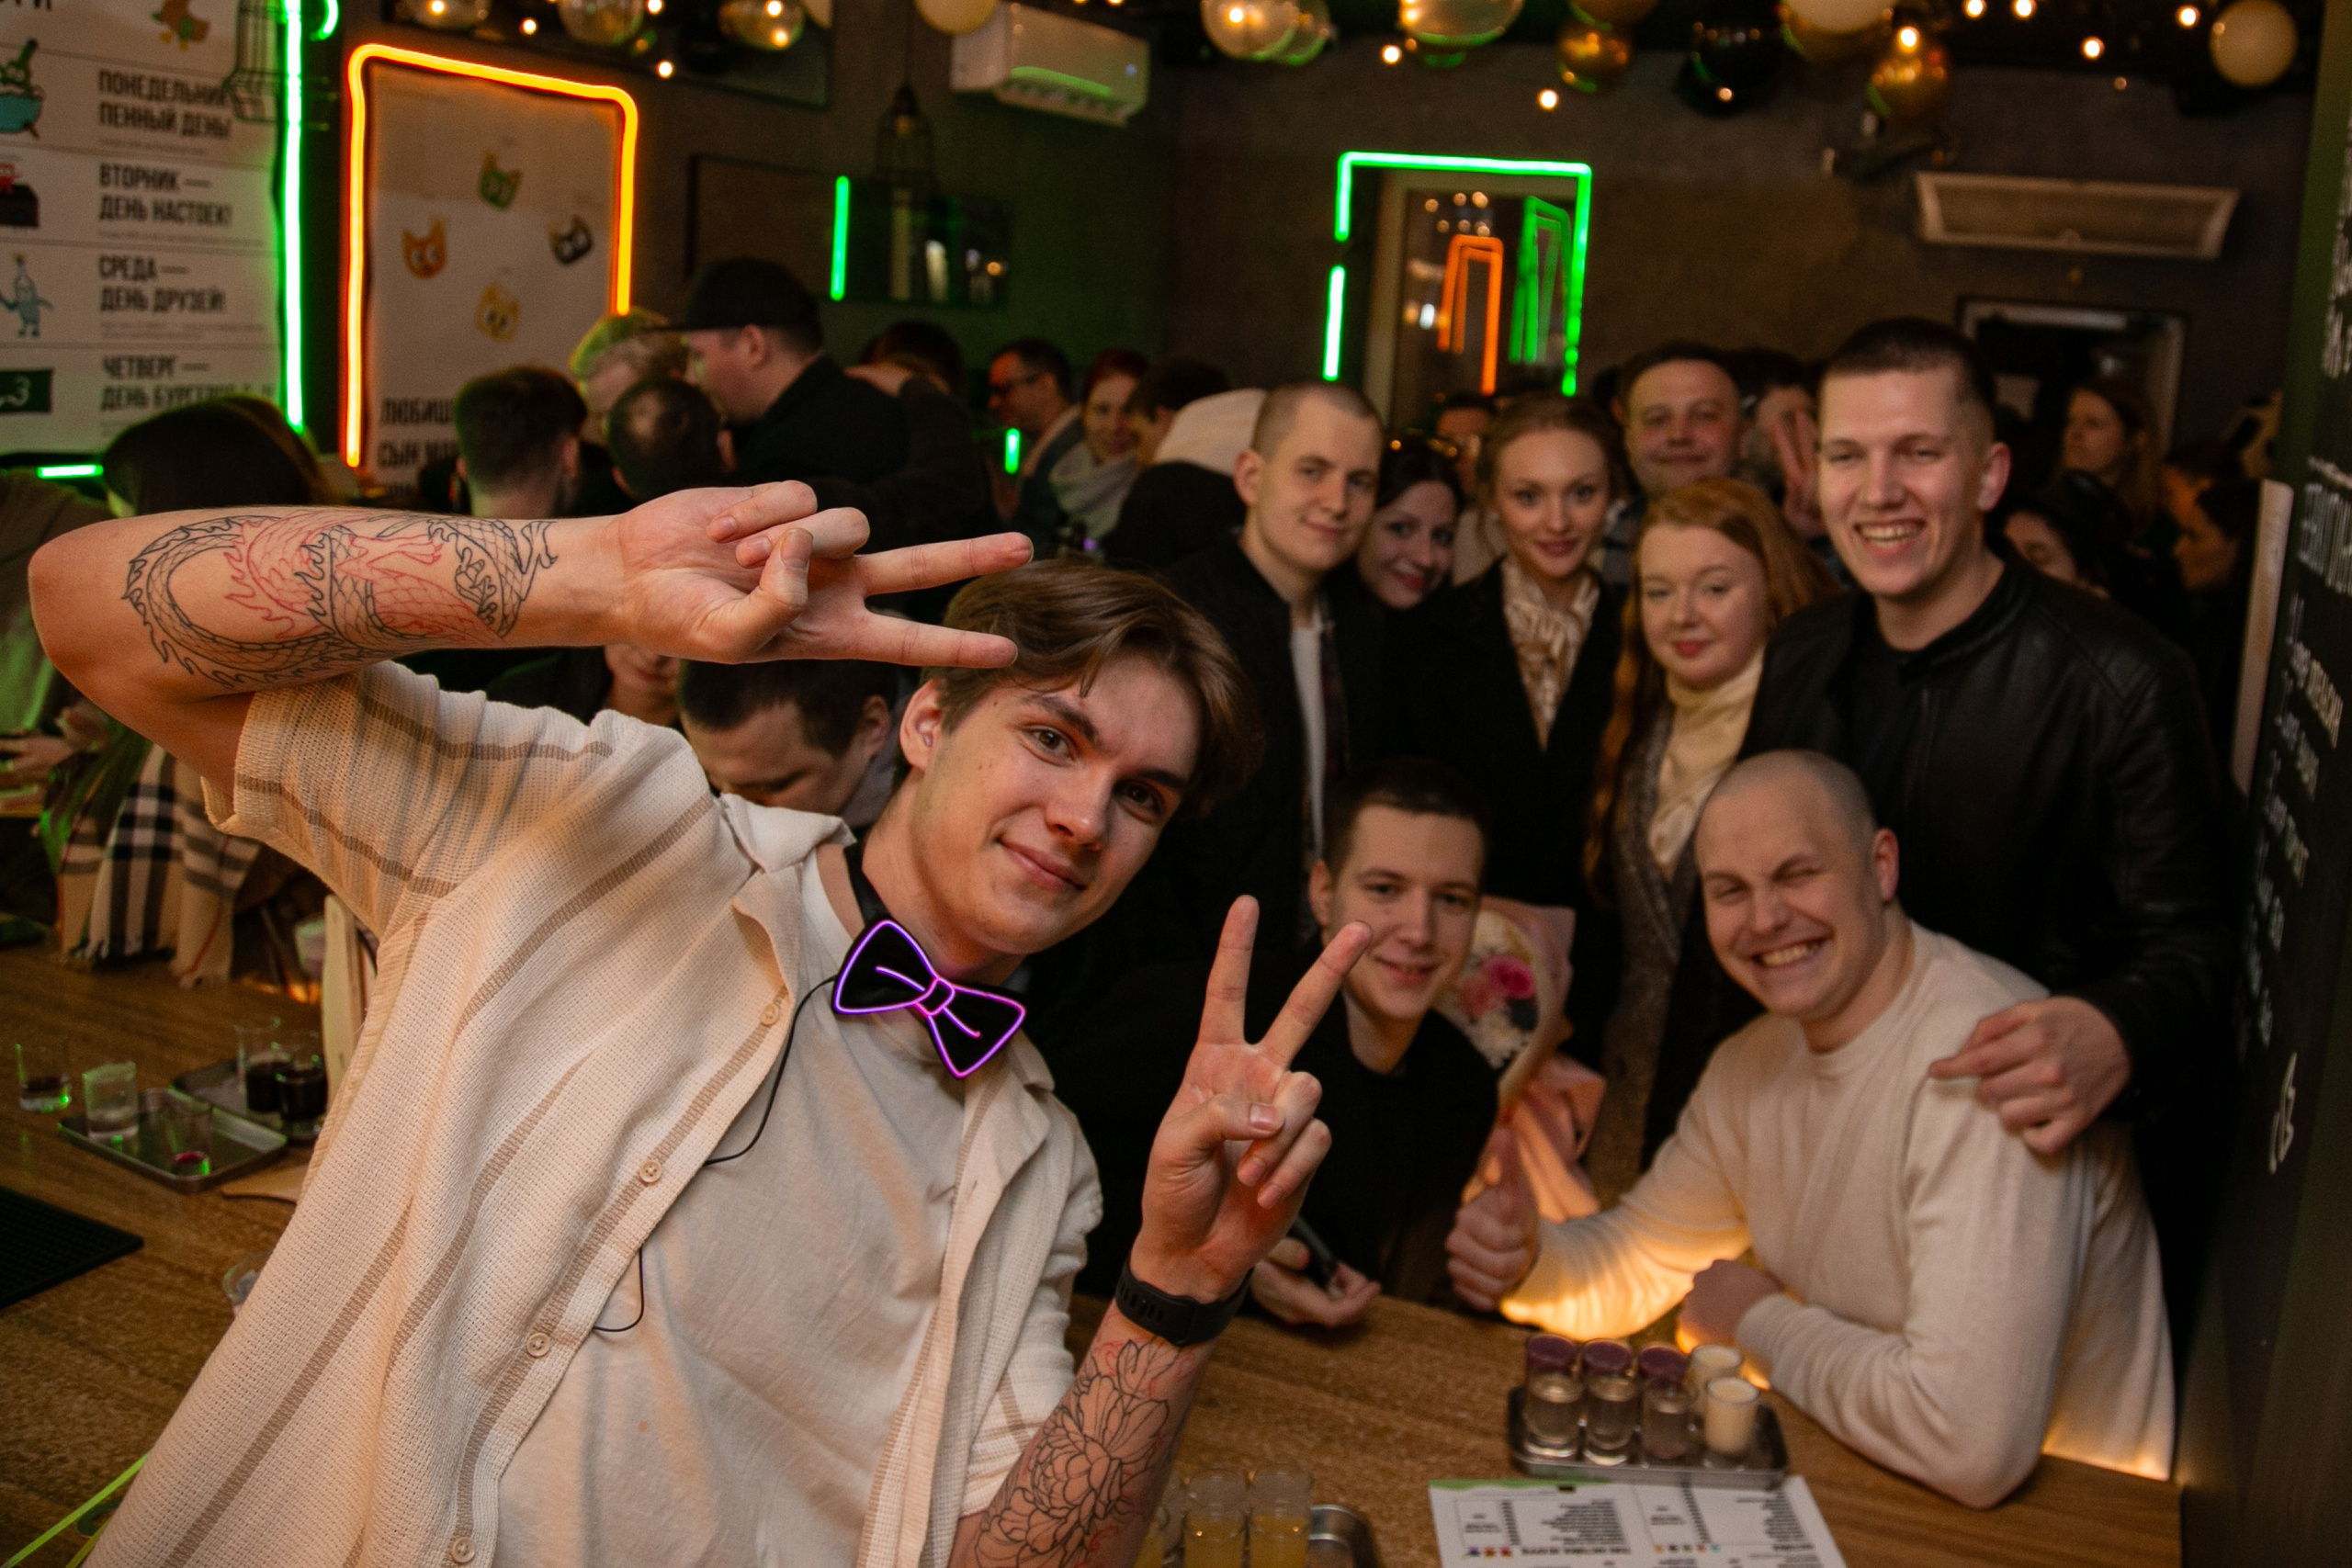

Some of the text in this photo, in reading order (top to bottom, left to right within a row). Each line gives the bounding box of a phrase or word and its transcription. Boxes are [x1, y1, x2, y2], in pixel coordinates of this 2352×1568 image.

[98, 100, 177, 133] ПЕННЫЙ
[99, 164, 180, 192] ВТОРНИК
[99, 194, 149, 222] ДЕНЬ
[98, 254, 158, 282] СРЕДА
[99, 286, 149, 313] ДЕНЬ
[103, 354, 178, 380] ЧЕТВЕРГ
[100, 384, 149, 411] ДЕНЬ
